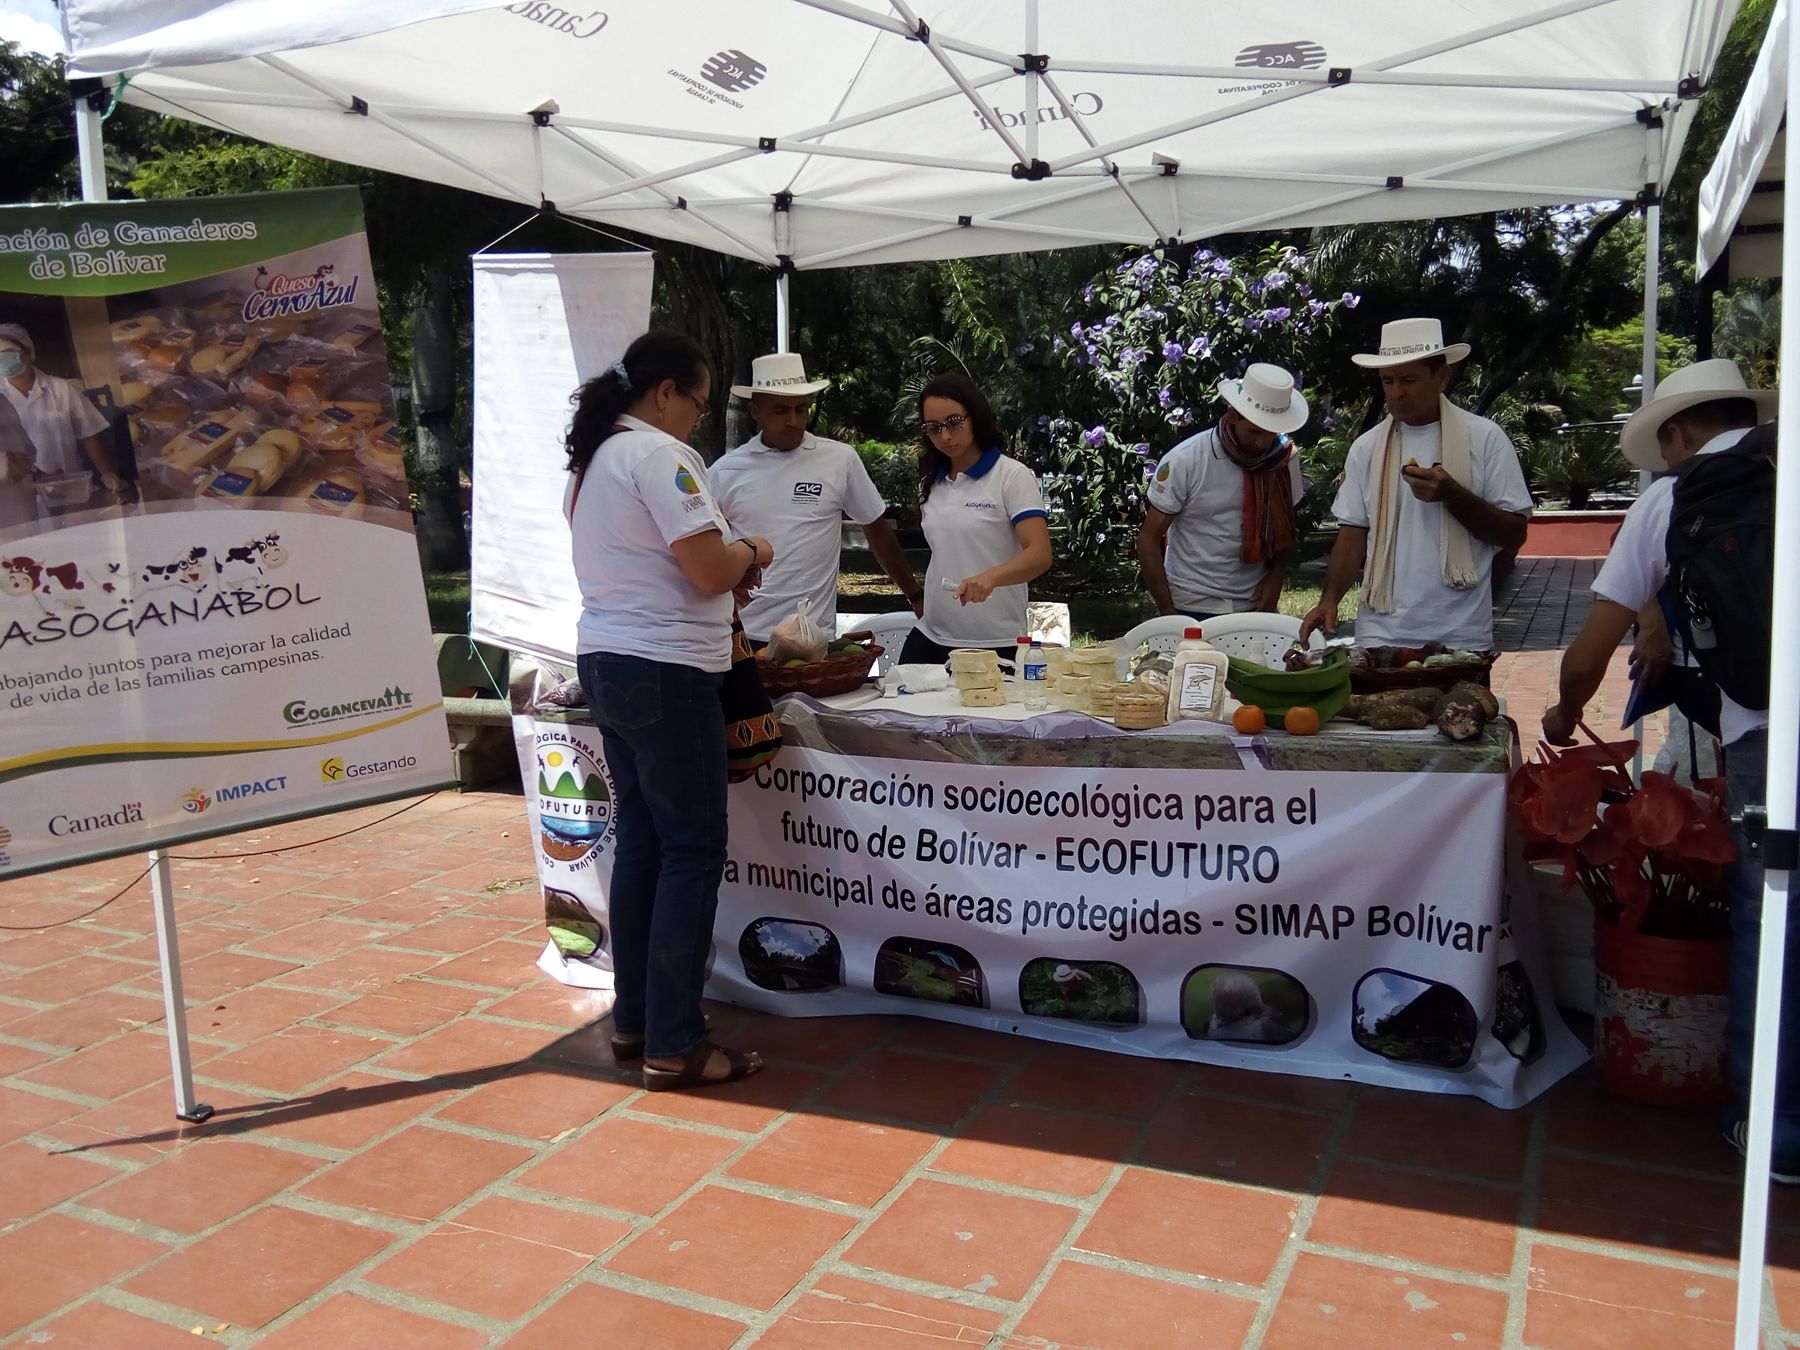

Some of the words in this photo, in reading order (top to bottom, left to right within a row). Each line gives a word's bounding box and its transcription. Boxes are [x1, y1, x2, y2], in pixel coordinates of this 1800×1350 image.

[75, 222, 110, 249] de
[114, 218, 258, 245] Ganaderos
[29, 254, 66, 280] de
[69, 250, 167, 277] Bolívar
[271, 275, 316, 295] Queso
[795, 483, 821, 493] CVC
[0, 583, 322, 649] ASOGANABOL
[10, 692, 33, 709] de
[40, 685, 81, 703] vida
[87, 681, 110, 697] de
[115, 677, 141, 692] las
[146, 664, 216, 688] familias
[220, 648, 324, 680] campesinas.
[88, 658, 146, 680] juntos
[151, 651, 192, 678] para
[198, 640, 267, 666] mejorar
[270, 633, 287, 650] la
[291, 623, 352, 646] calidad
[215, 776, 288, 803] IMPACT
[346, 755, 417, 778] Gestando
[570, 736, 595, 759] PARA
[595, 757, 607, 773] EL
[603, 827, 616, 844] DE
[754, 763, 934, 809] Corporación
[943, 781, 1183, 827] socioecológica
[1195, 792, 1274, 830] para
[1286, 788, 1317, 825] el
[781, 811, 859, 854] futuro
[867, 824, 906, 860] de
[916, 828, 1027, 870] Bolívar
[1056, 835, 1280, 884] ECOFUTURO
[747, 859, 873, 908] municipal
[882, 879, 917, 912] de
[925, 884, 1012, 925] áreas
[1021, 894, 1201, 941] protegidas
[1235, 903, 1355, 941] SIMAP
[1367, 903, 1492, 954] Bolívar
